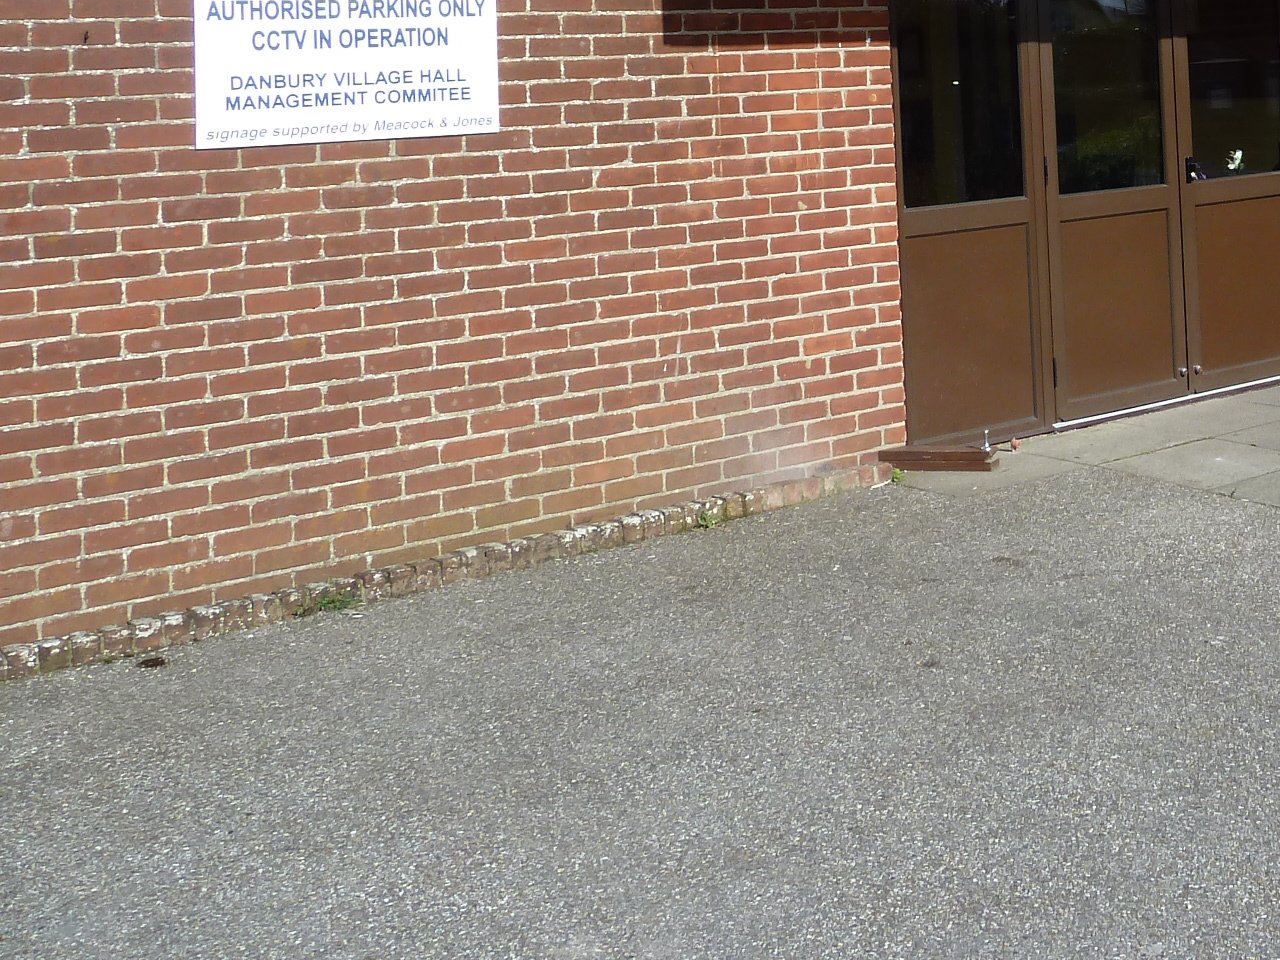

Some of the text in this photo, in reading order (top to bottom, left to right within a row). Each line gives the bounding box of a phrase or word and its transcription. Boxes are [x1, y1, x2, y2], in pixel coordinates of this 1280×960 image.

[206, 0, 341, 21] AUTHORISED
[252, 27, 449, 51] CCTV IN OPERATION
[230, 68, 466, 90] DANBURY VILLAGE HALL
[225, 87, 471, 111] MANAGEMENT COMMITEE
[206, 115, 493, 142] signage supported by Meacock & Jones
